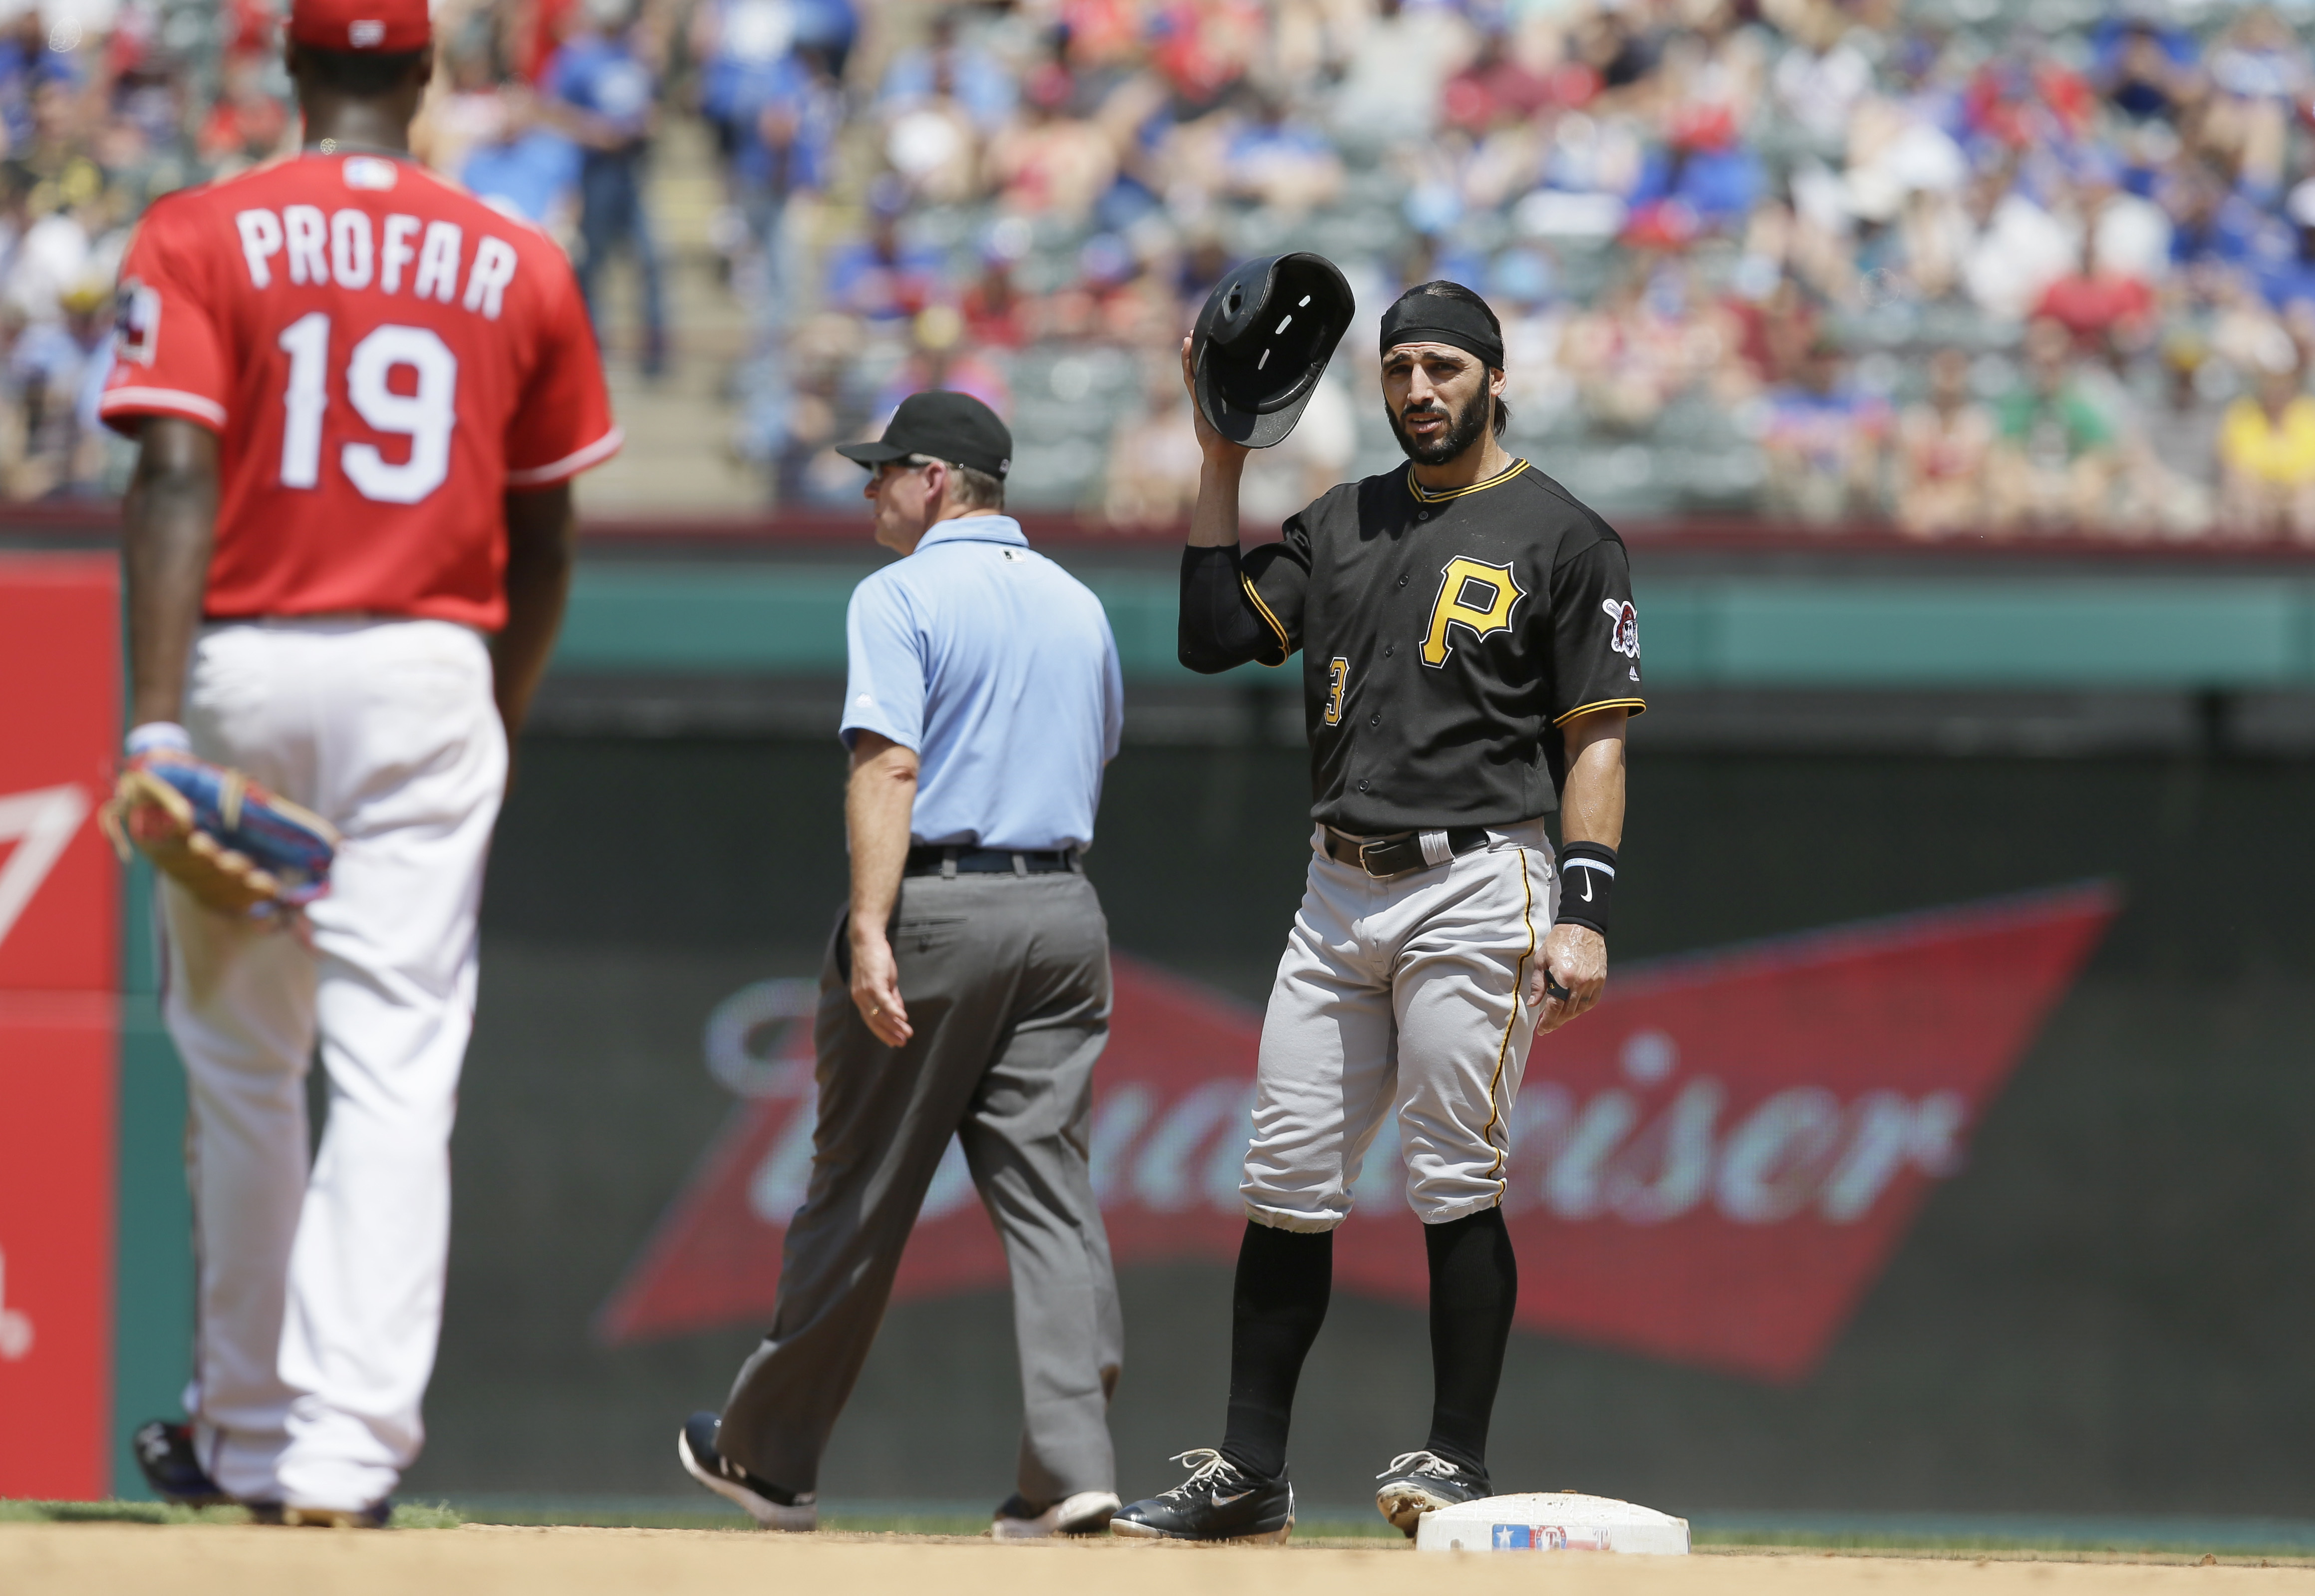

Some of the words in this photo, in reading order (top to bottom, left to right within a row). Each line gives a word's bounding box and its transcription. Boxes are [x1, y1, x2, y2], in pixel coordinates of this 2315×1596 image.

[236, 205, 518, 320] PROFAR
[279, 311, 458, 505] 19
[1419, 555, 1527, 669] P
[1324, 656, 1350, 727] 3
